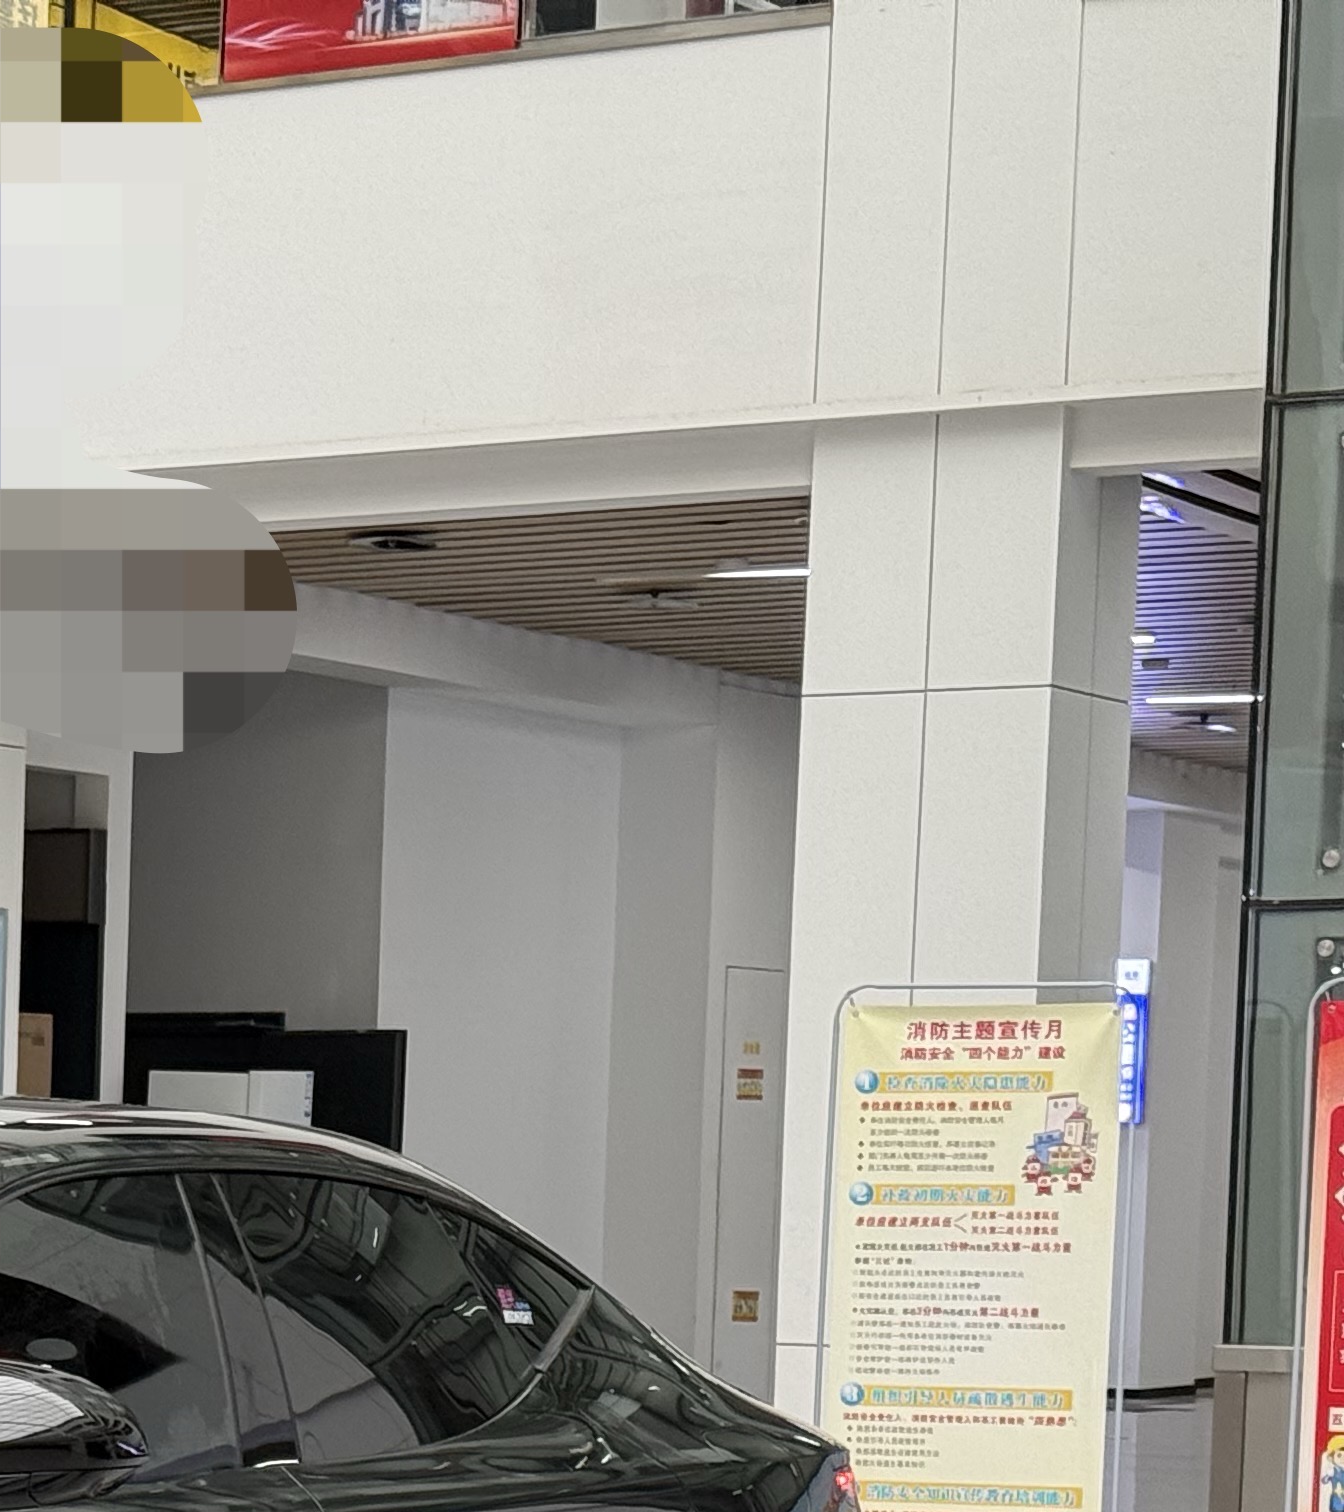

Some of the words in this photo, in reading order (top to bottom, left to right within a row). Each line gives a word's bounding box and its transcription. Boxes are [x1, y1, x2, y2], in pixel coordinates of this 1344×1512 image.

[906, 1019, 1064, 1041] 消防主题宣传月
